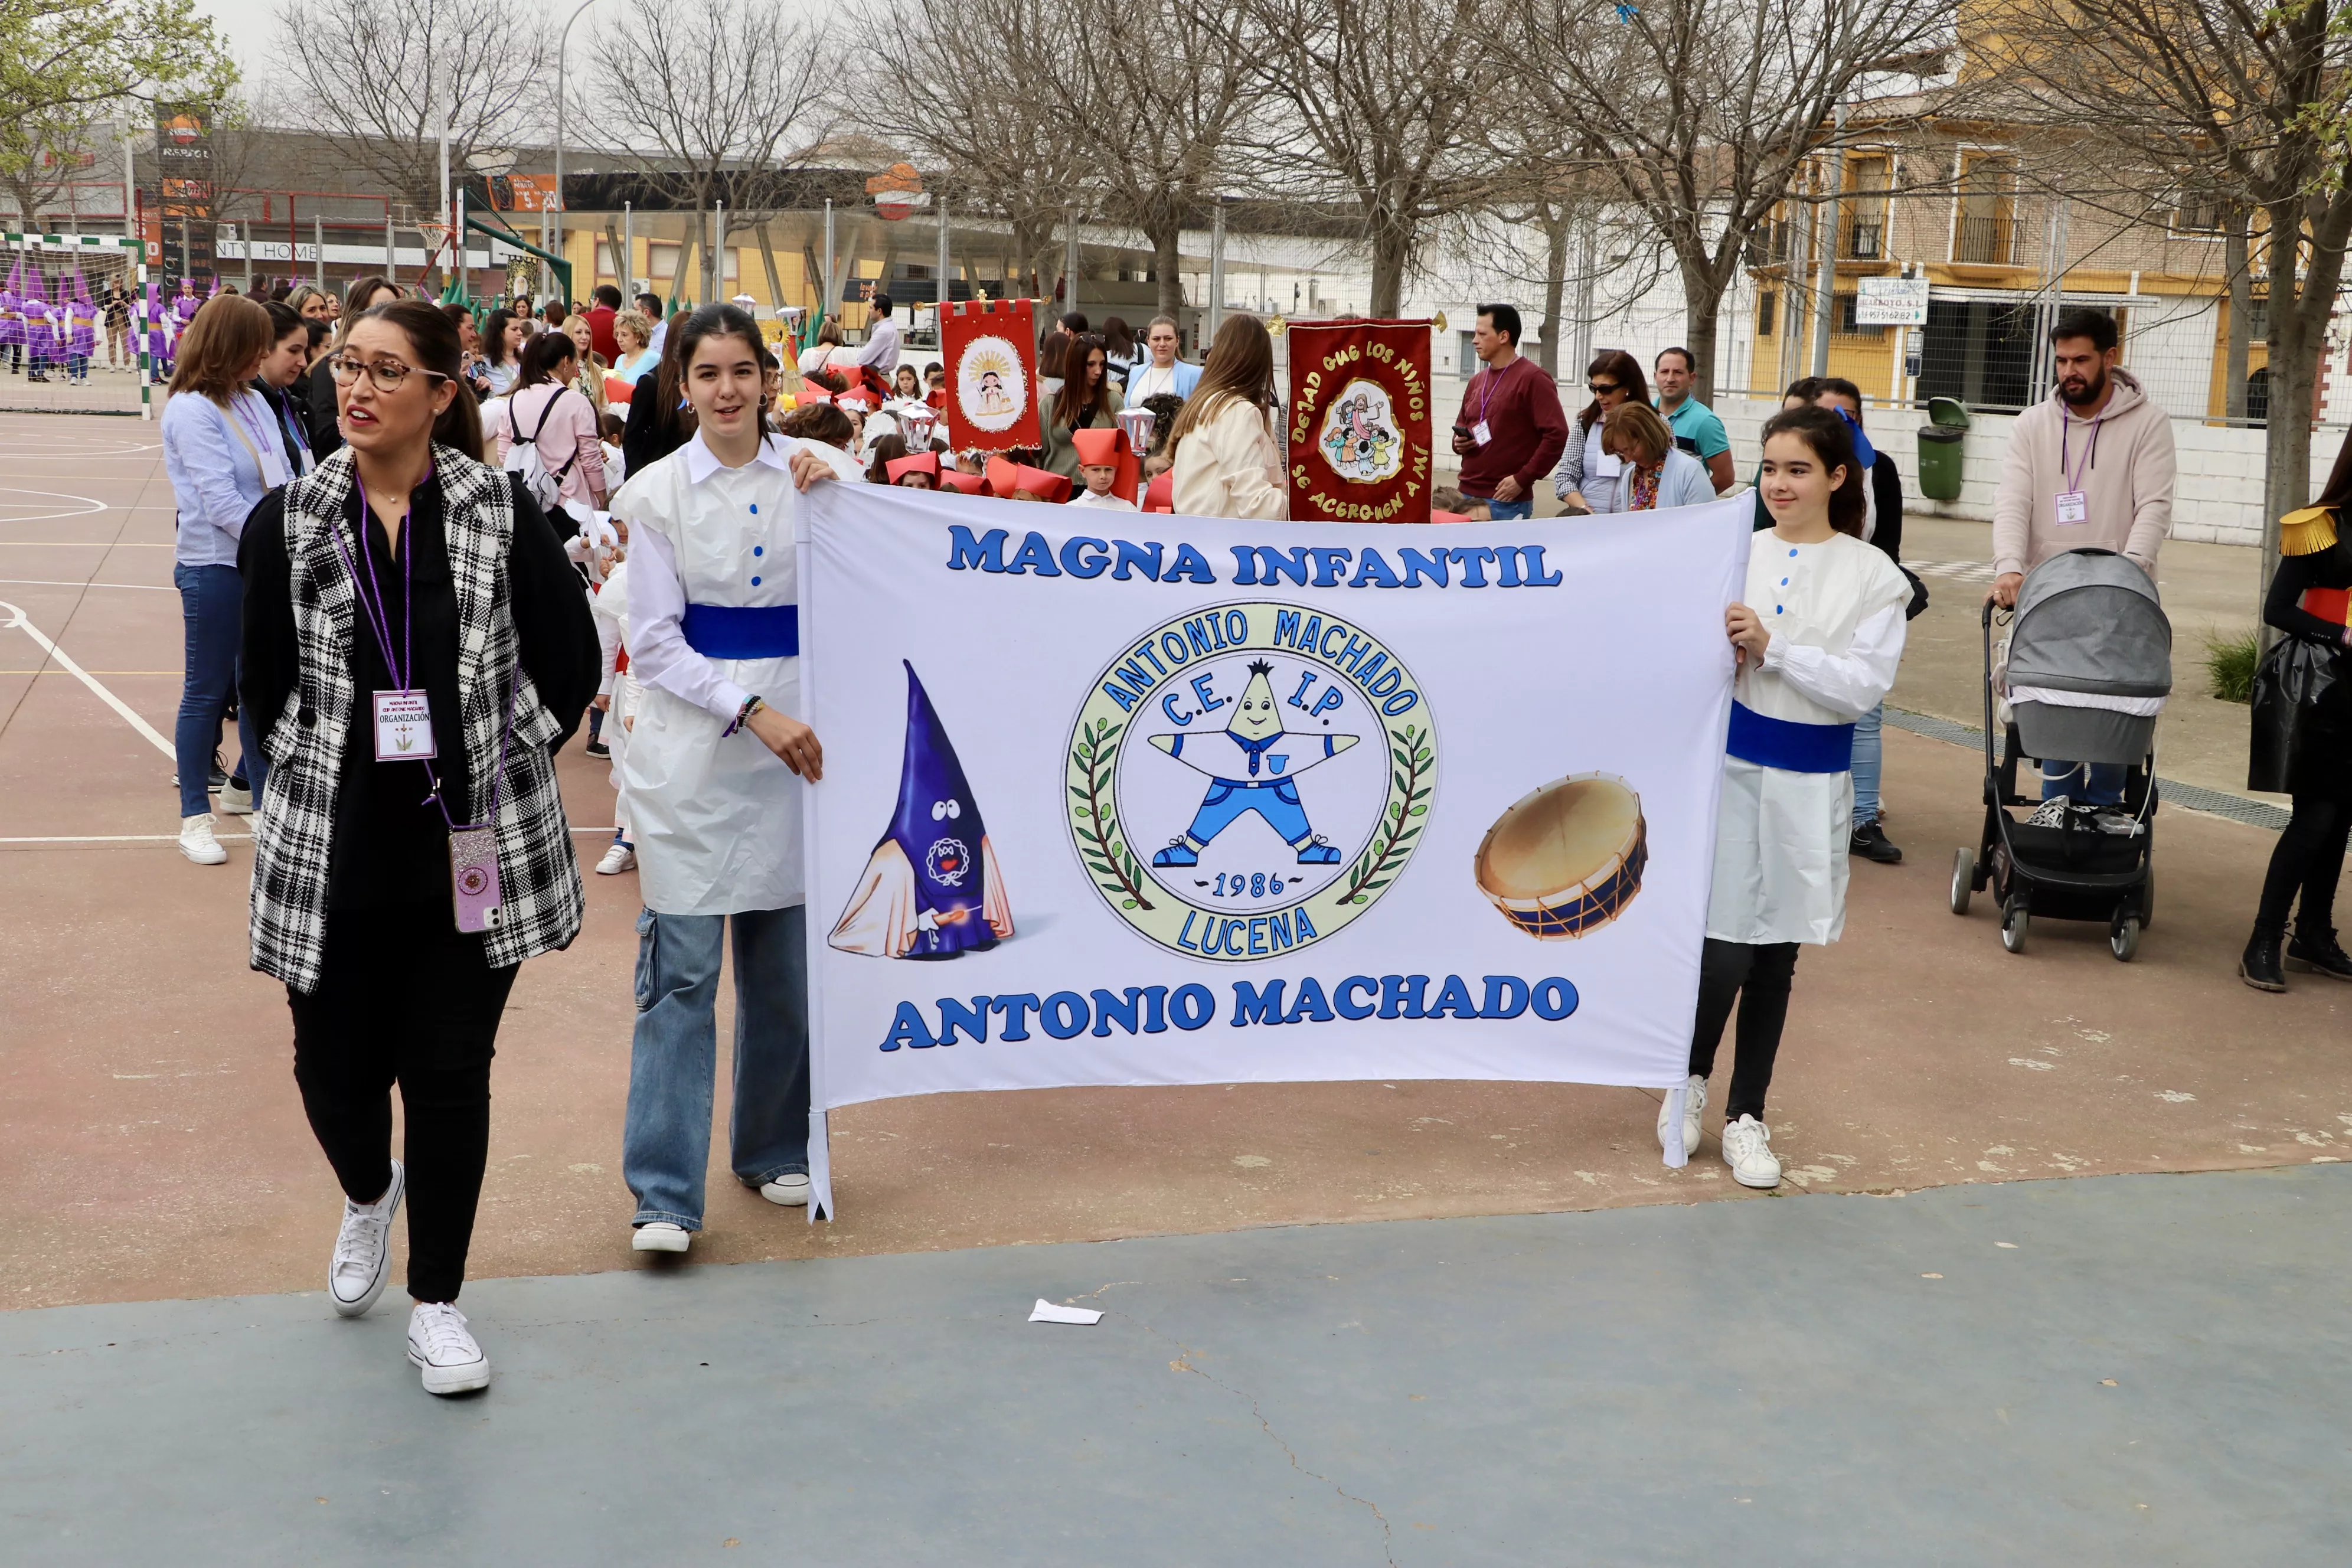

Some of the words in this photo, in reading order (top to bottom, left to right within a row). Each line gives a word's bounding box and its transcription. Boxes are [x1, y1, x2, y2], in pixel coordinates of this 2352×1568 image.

[523, 191, 532, 208] 5
[264, 243, 318, 259] HOME
[1292, 371, 1321, 444] DEJAD
[1322, 344, 1360, 371] QUE
[1366, 341, 1394, 364] LOS
[1394, 358, 1425, 422] NIÑOS
[1292, 464, 1311, 489] SE
[1308, 491, 1404, 521] ACERQUEN
[1404, 481, 1420, 497] A
[1412, 442, 1429, 480] MÍ
[946, 525, 1217, 584] MAGNA
[1230, 545, 1563, 589] INFANTIL
[1102, 610, 1247, 713] ANTONIO
[1273, 609, 1418, 717] MACHADO
[380, 711, 430, 723] ORGANIZACIÓN
[1162, 672, 1233, 726] C.E.
[1288, 671, 1344, 726] I.P.
[1177, 907, 1318, 956] LUCENA
[879, 983, 1216, 1053] ANTONIO
[1230, 975, 1580, 1028] MACHADO
